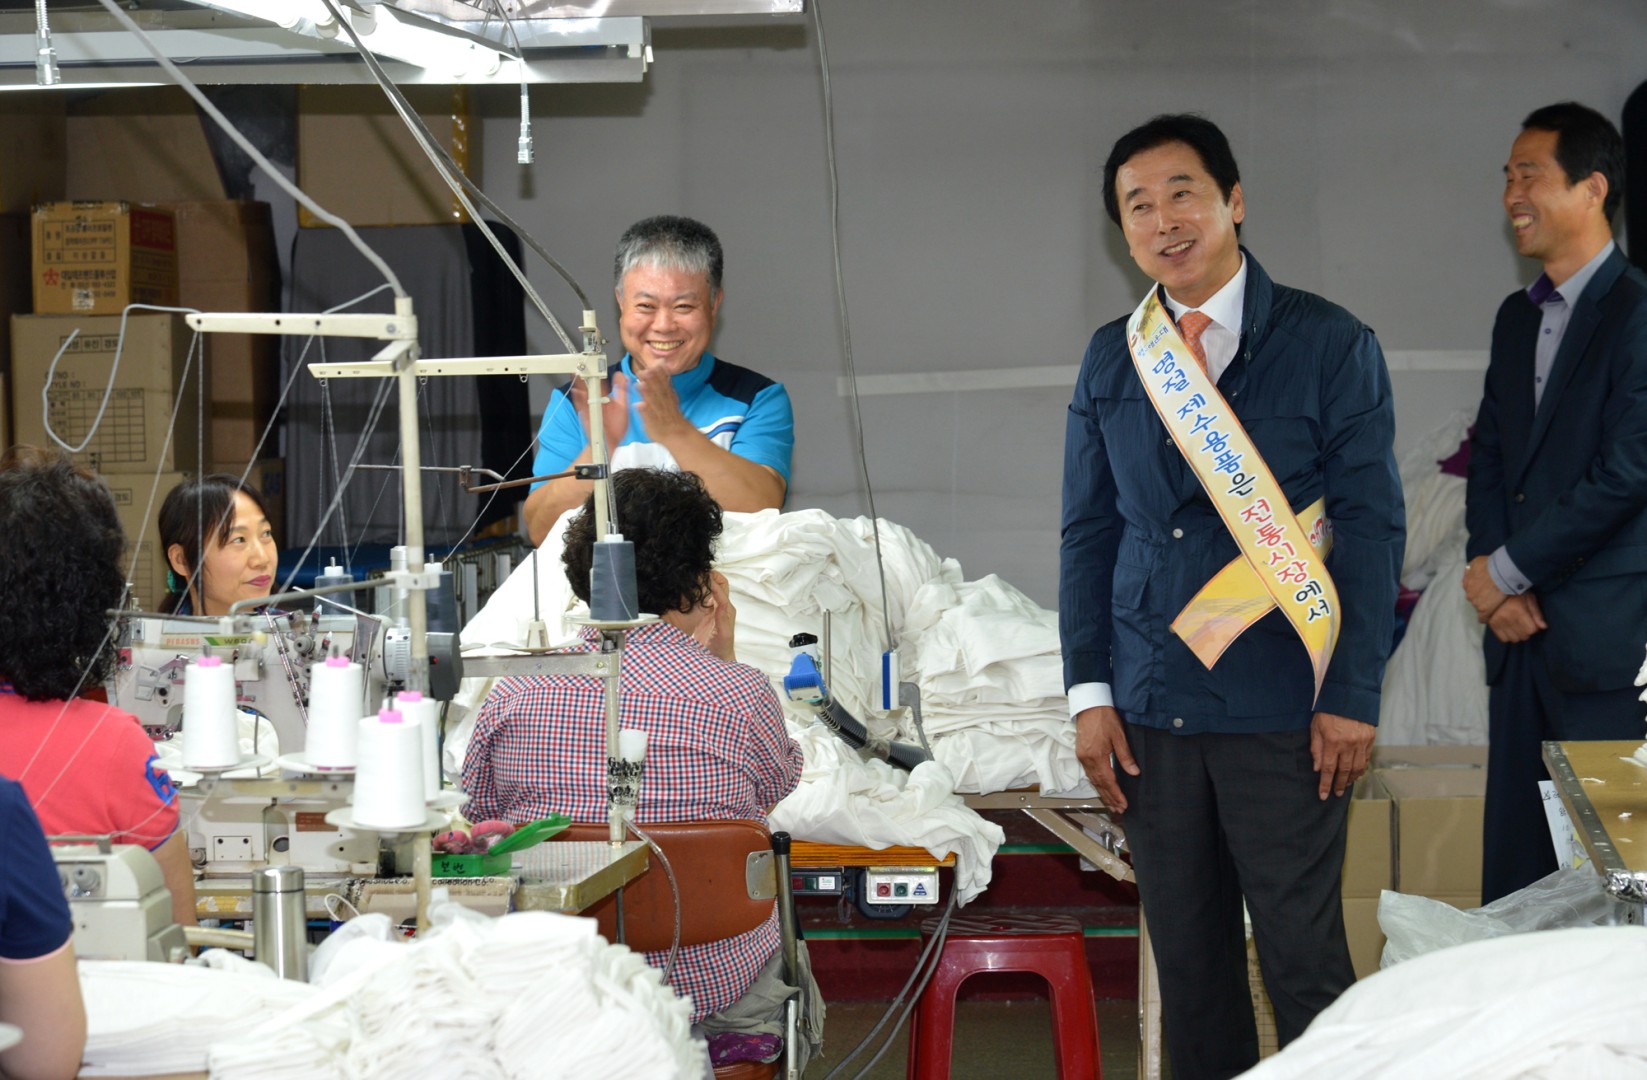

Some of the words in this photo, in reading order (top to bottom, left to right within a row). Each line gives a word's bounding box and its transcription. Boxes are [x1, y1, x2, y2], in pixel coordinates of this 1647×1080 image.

[1152, 350, 1190, 395] 명절
[1177, 393, 1256, 496] 제수용품은
[1240, 498, 1330, 622] 전통시장에서
